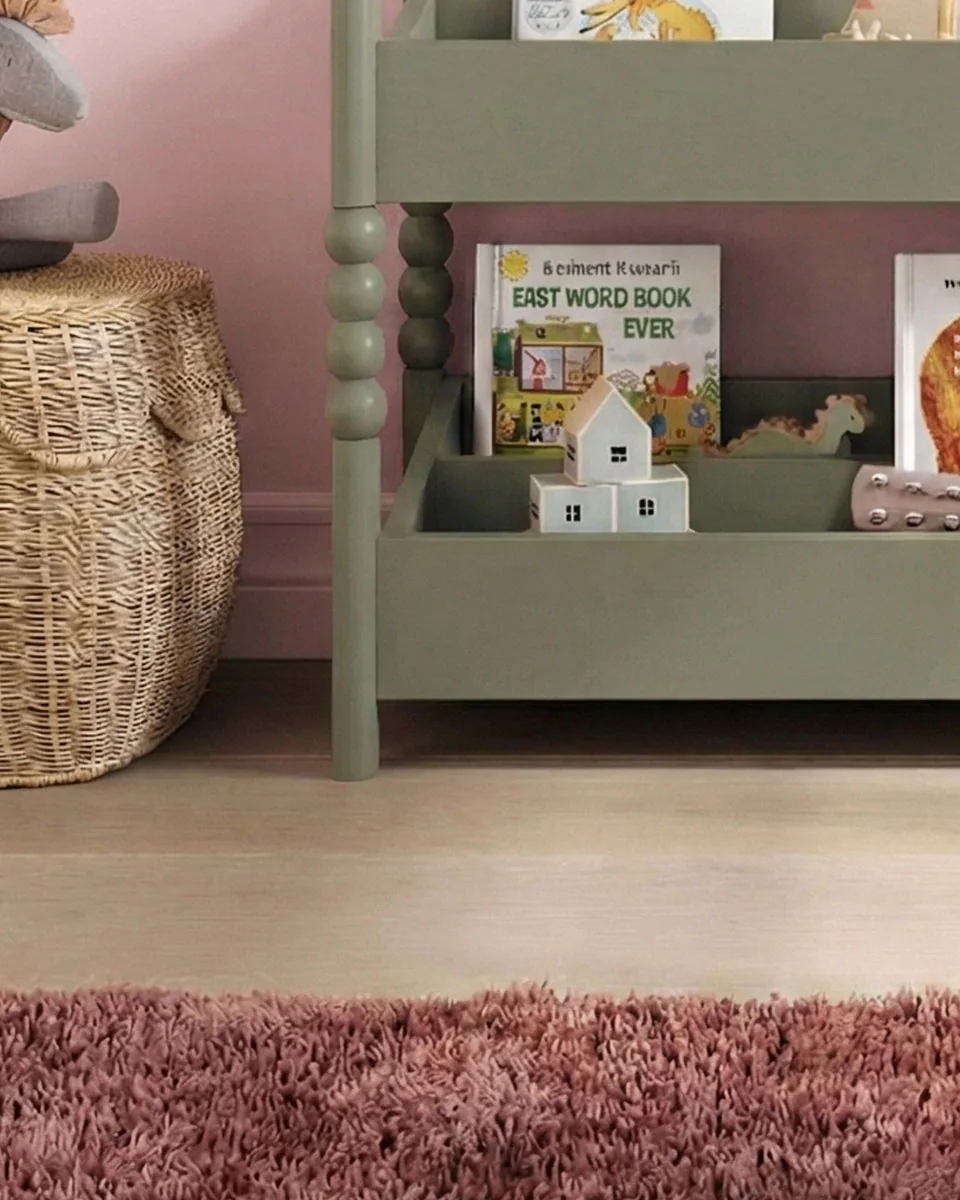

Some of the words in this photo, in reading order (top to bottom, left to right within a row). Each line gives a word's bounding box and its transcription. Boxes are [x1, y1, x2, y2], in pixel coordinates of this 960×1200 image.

[512, 287, 562, 309] EAST
[566, 287, 629, 309] WORD
[634, 287, 692, 309] BOOK
[623, 316, 675, 340] EVER
